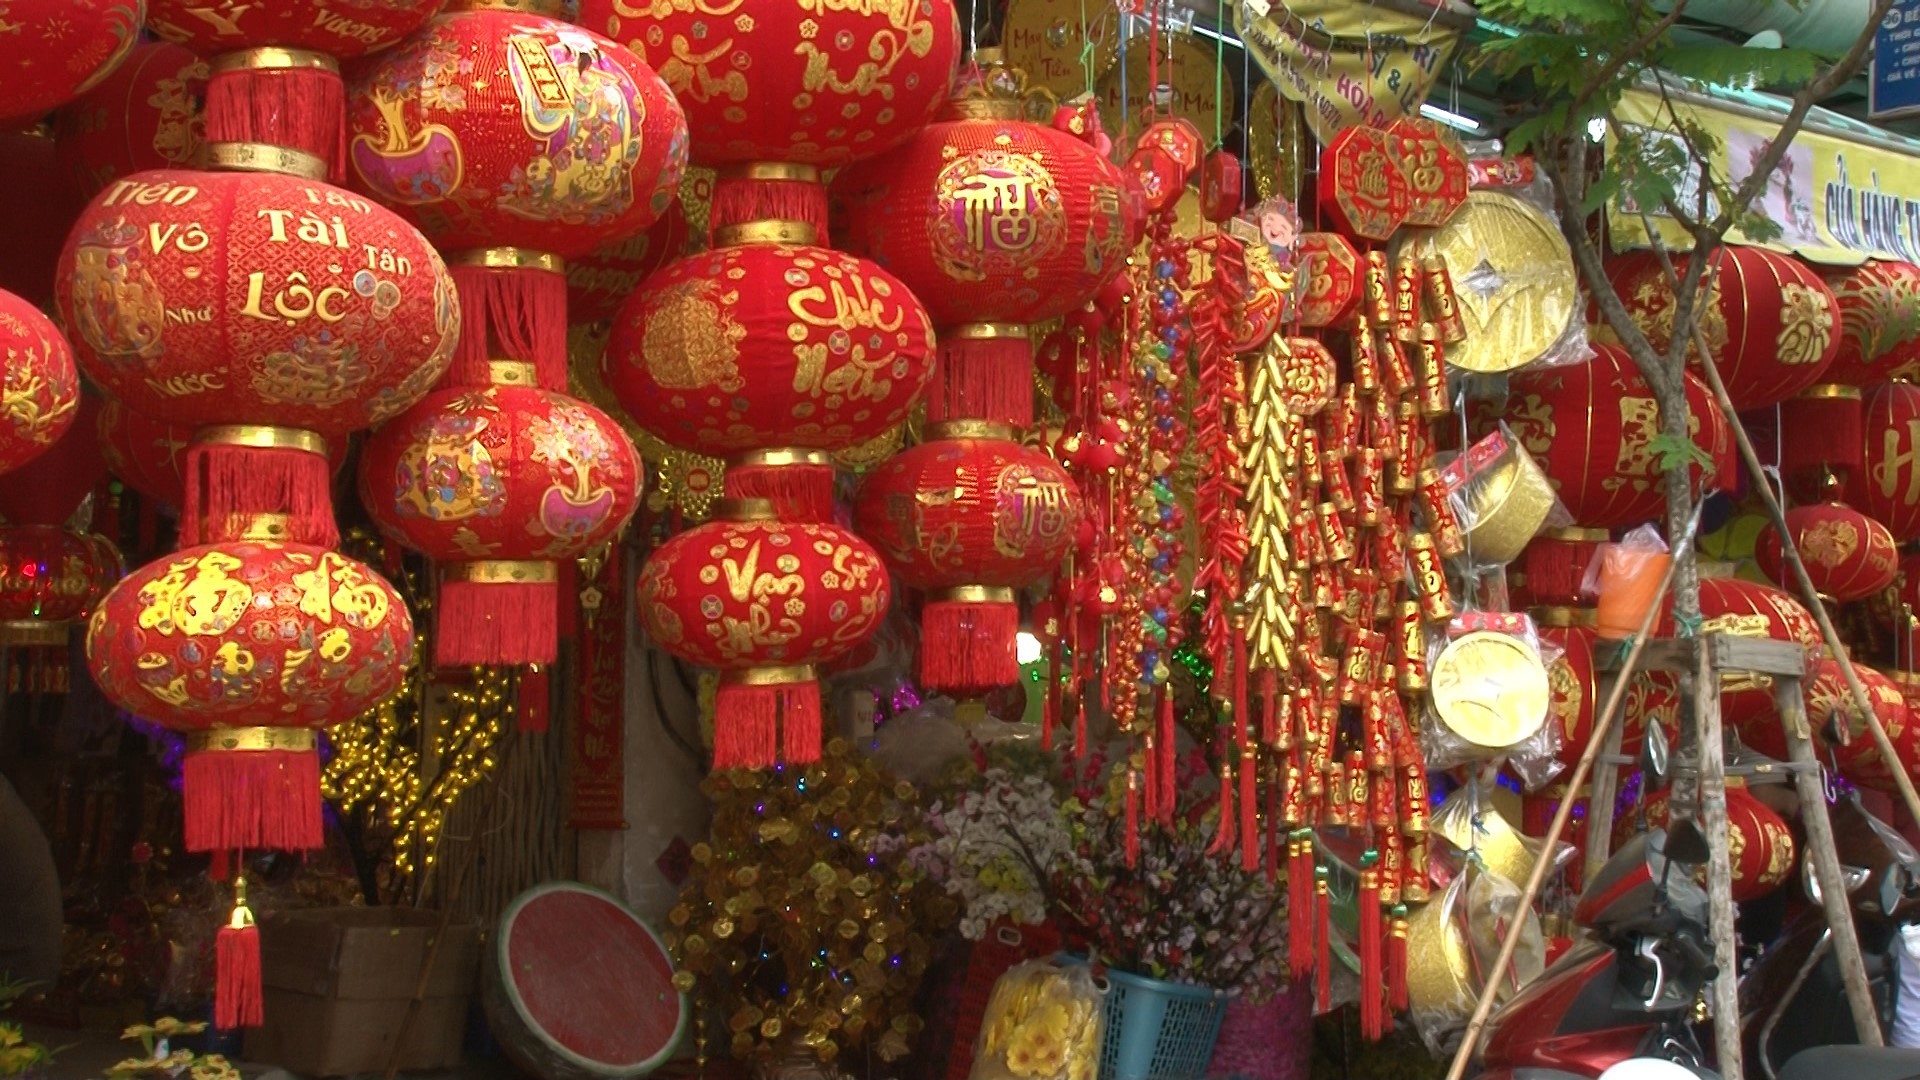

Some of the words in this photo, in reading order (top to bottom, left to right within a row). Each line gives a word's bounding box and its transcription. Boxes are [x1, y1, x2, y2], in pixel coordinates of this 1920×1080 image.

[148, 221, 210, 256] Vô
[256, 203, 350, 249] Tài
[165, 304, 214, 327] Như
[240, 270, 351, 327] Lộc
